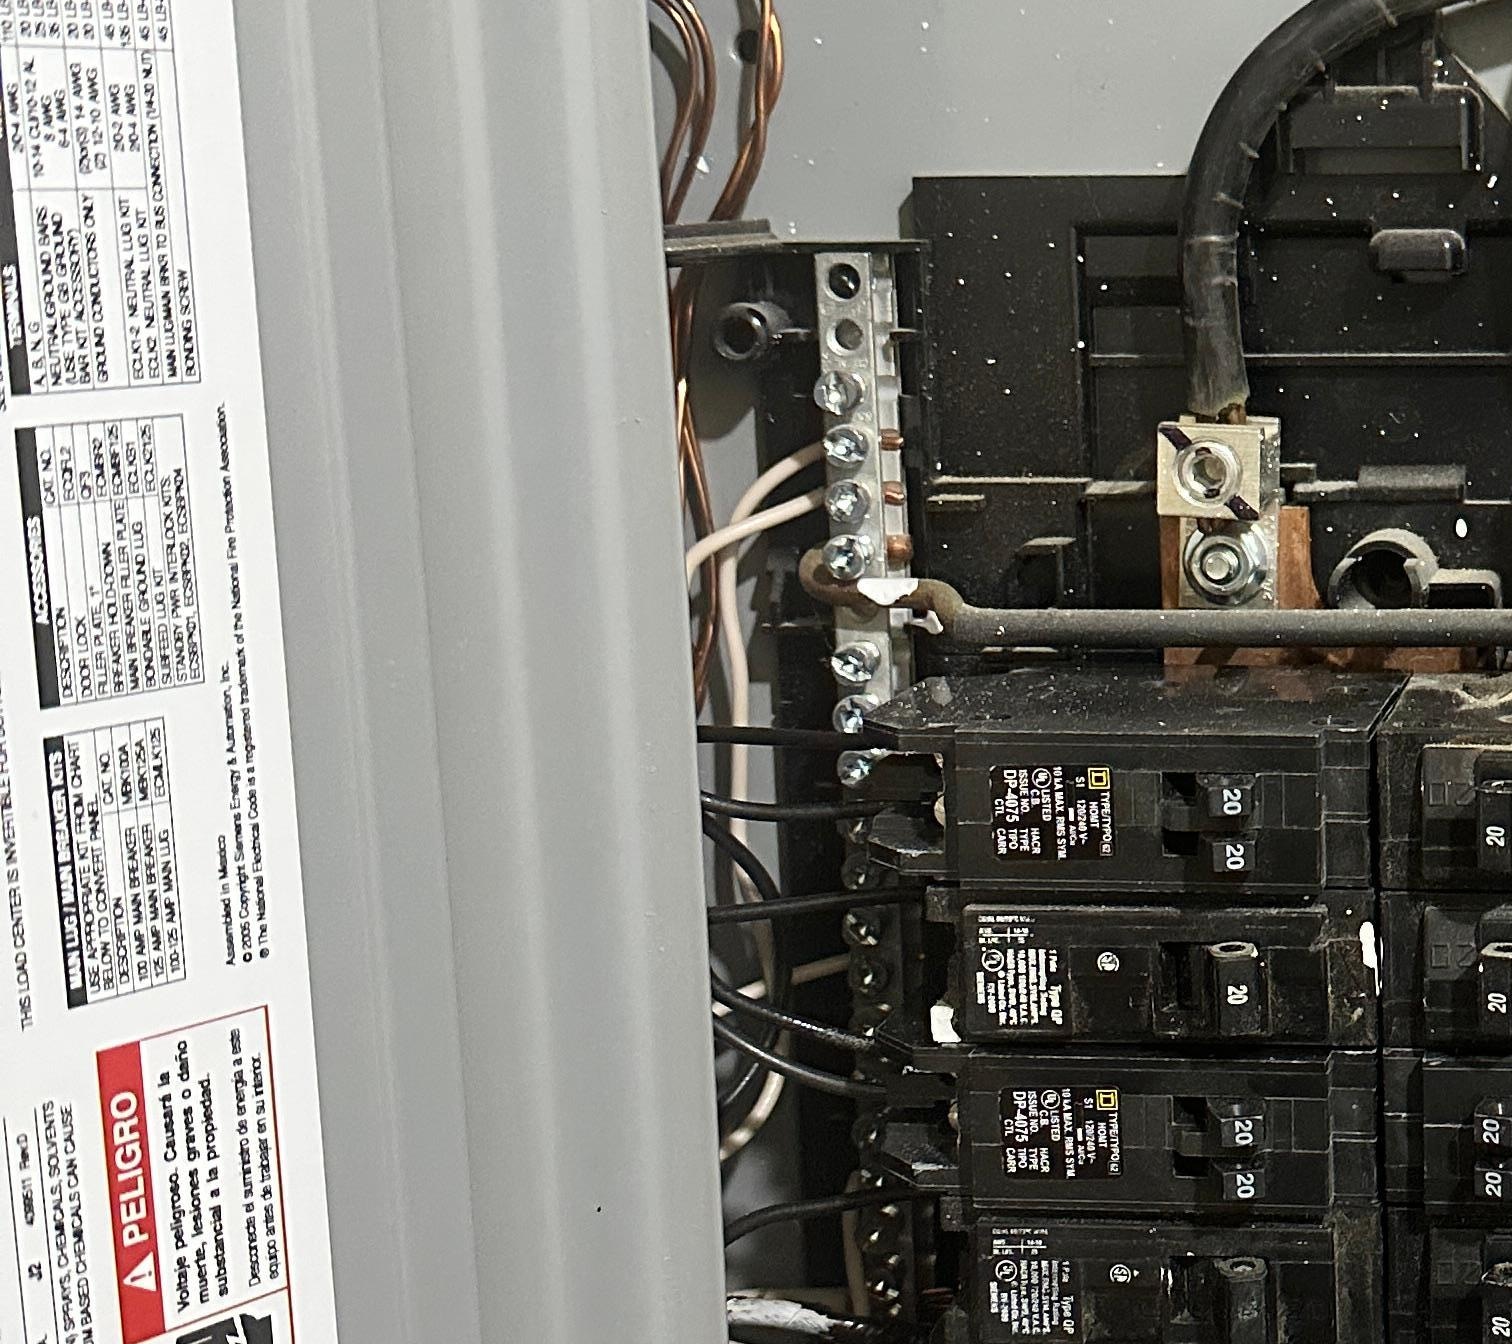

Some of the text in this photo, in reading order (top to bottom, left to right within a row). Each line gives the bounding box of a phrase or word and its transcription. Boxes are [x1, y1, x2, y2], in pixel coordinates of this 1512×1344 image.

[1, 263, 23, 349] TERMINALS
[177, 269, 196, 376] BONDING SCREW
[26, 515, 50, 625] ACCESSORIES
[74, 615, 93, 698] DOOR LOCK
[1003, 769, 1019, 823] DP-4075
[1041, 789, 1052, 822] LISTED
[1222, 788, 1241, 816] 20
[1485, 826, 1506, 847] 20
[48, 750, 83, 990] MAIN LUG / MAIN BREAKER KITS
[1225, 843, 1245, 870] 20
[1227, 984, 1248, 1006] 20
[1488, 992, 1507, 1014] 20
[229, 1027, 241, 1055] este
[232, 1056, 242, 1066] a
[235, 1118, 248, 1135] de
[1013, 1091, 1029, 1142] DP-4075
[1050, 1110, 1061, 1141] LISTED
[1234, 1119, 1253, 1145] 20
[1482, 1118, 1500, 1144] 20
[42, 1099, 60, 1178] SOLVENTS
[109, 1090, 149, 1247] PELIGRO
[174, 1039, 209, 1304] muerte, lesiones graves o daño
[238, 1137, 254, 1199] suministro
[251, 1052, 280, 1279] equipo antes de trabajar en su interior.
[157, 1070, 190, 1313] Voltaje peligroso. Causará la
[197, 1072, 228, 1297] substancial a la propiedad.
[1236, 1173, 1255, 1199] 20
[1484, 1172, 1503, 1198] 20
[242, 1200, 255, 1213] el
[244, 1215, 261, 1287] Desconecte
[1492, 1316, 1512, 1337] 20
